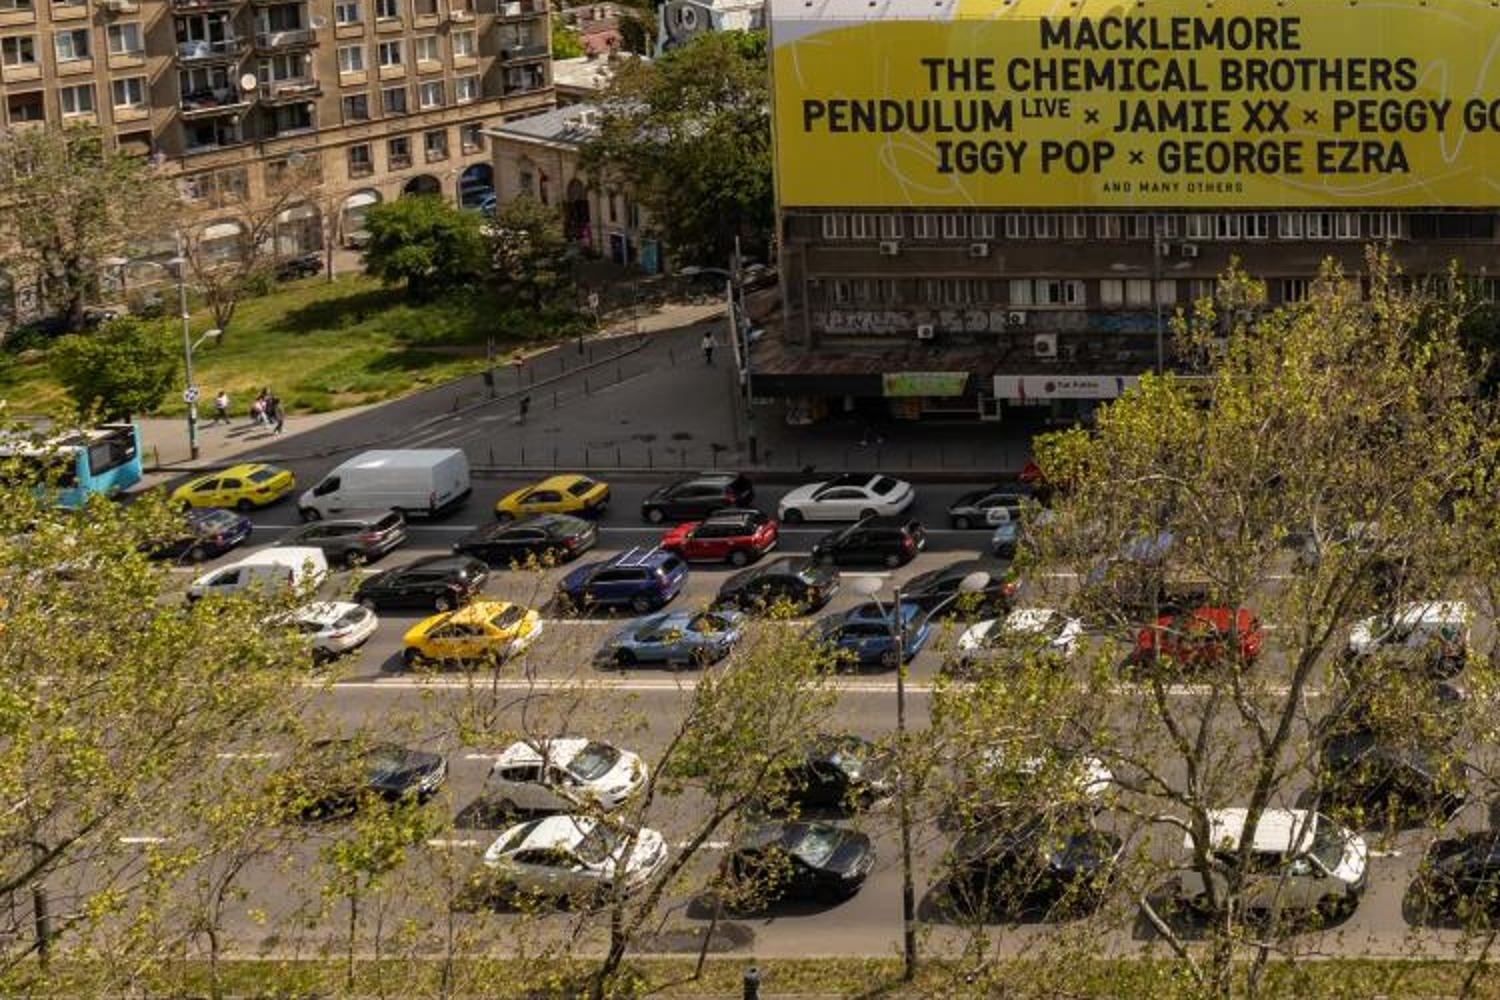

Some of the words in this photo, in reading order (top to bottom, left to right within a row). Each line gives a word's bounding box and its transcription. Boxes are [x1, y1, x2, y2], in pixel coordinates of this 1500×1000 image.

[1041, 17, 1300, 50] MACKLEMORE
[922, 58, 995, 91] THE
[1008, 58, 1208, 91] CHEMICAL
[1221, 58, 1416, 91] BROTHERS
[804, 100, 1012, 132] PENDULUM
[1022, 99, 1070, 118] LIVE
[1114, 100, 1230, 132] JAMIE
[1243, 100, 1290, 133] XX
[1334, 100, 1451, 132] PEGGY
[936, 141, 1027, 174] IGGY
[1042, 141, 1114, 174] POP
[1158, 141, 1303, 174] GEORGE
[1318, 141, 1410, 173] EZRA
[1103, 182, 1133, 193] AND
[1140, 182, 1179, 193] MANY
[1187, 182, 1243, 193] OTHERS
